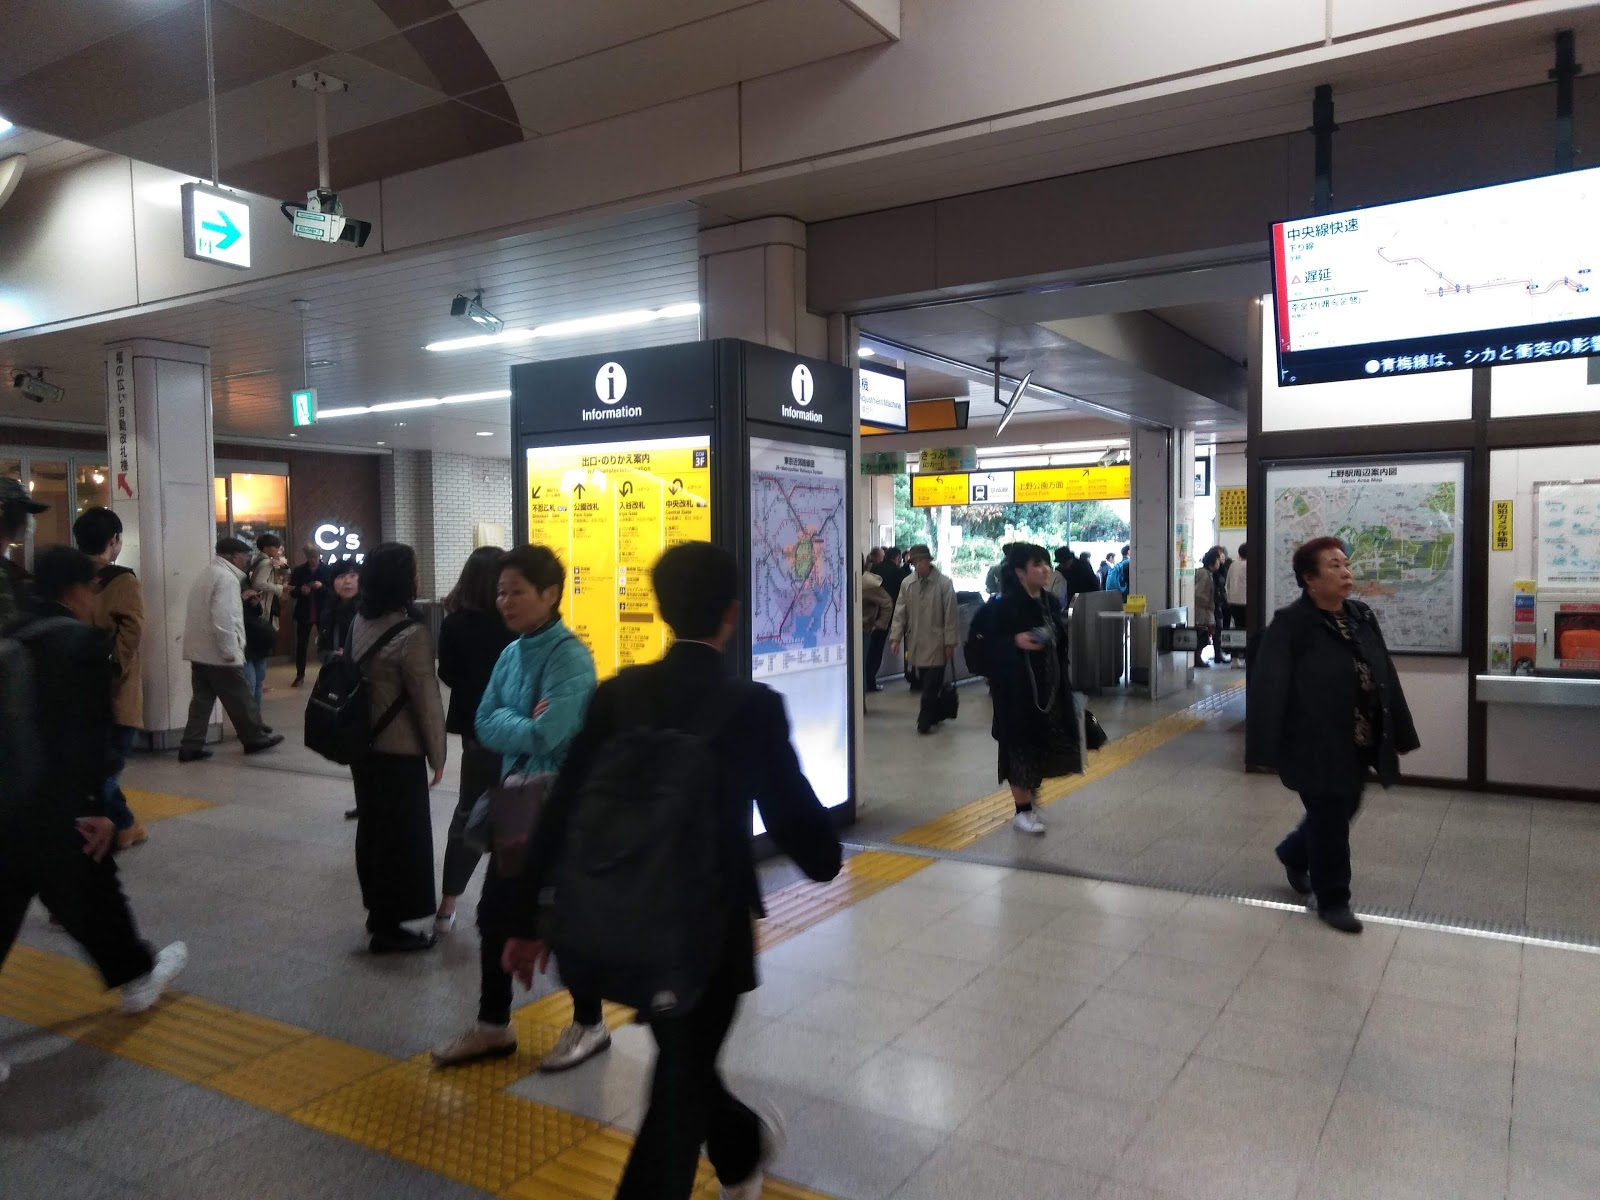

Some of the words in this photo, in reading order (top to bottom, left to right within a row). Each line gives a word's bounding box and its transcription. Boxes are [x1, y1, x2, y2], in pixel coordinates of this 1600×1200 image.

[1287, 218, 1359, 241] 中央線快速
[1304, 268, 1332, 284] 遅延
[582, 405, 643, 421] Information
[781, 404, 823, 424] Information
[920, 449, 948, 460] きっぷ
[695, 457, 705, 467] 3F
[1327, 467, 1398, 478] 上野駅周辺案内図
[1018, 481, 1064, 491] 上野公園方面
[573, 502, 600, 511] 公園改札
[619, 501, 645, 510] 入谷改札
[665, 499, 694, 508] 中央改札
[1497, 502, 1508, 549] 防犯カメラ作動中
[314, 523, 361, 551] C's
